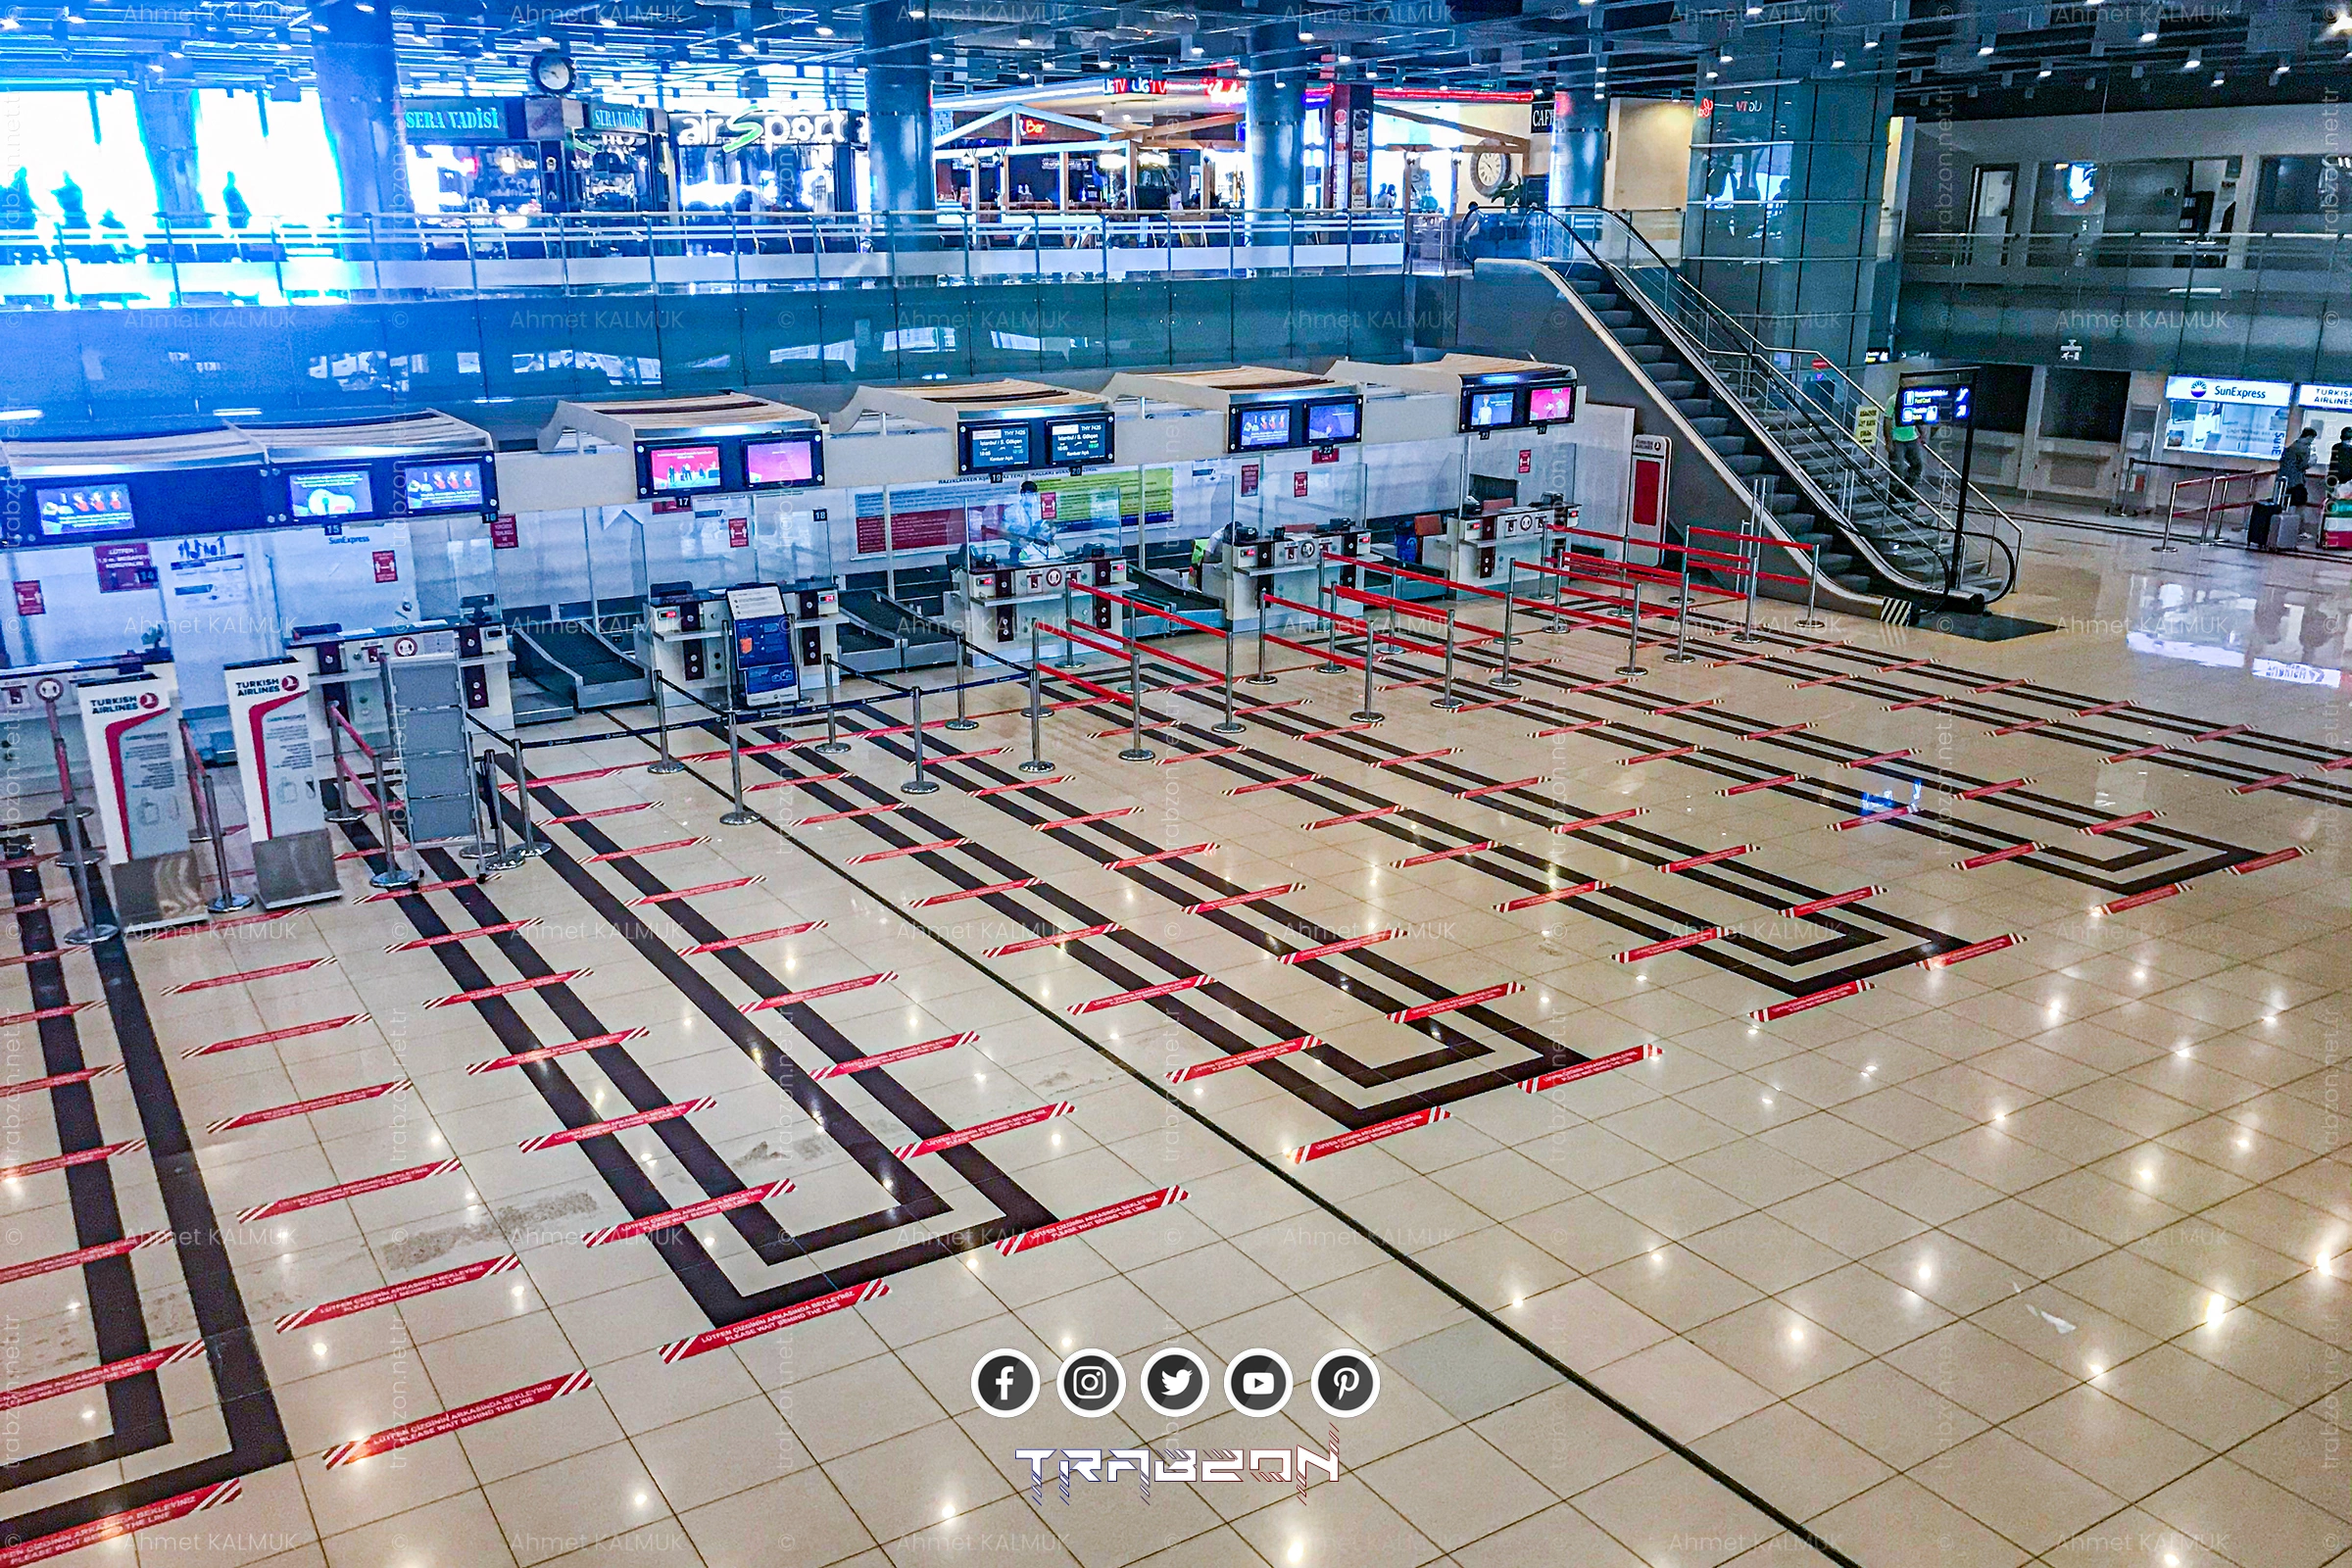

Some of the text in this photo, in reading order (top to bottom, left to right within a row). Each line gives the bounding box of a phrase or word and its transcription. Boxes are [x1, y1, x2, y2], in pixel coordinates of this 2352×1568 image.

[406, 111, 444, 128] SERA
[1025, 120, 1046, 134] Bar
[2215, 386, 2267, 400] SunExpress
[678, 498, 689, 507] 17
[326, 524, 340, 534] 15
[328, 535, 370, 545] SunExpress
[235, 678, 279, 689] TURKISH
[237, 685, 280, 697] AIRLINES
[90, 695, 137, 707] TURKISH
[92, 703, 138, 714] AIRLINES
[701, 1328, 732, 1344] LÜTFEN
[766, 1303, 810, 1323] ARKASINDA
[811, 1291, 855, 1309] BEKLEYİNİZ
[725, 1301, 840, 1343] PLEASE WAIT BEHIND THE LINE
[373, 1427, 409, 1445] LÜTFEN
[452, 1398, 503, 1421] ARKASINDA
[504, 1383, 554, 1405] BEKLEYİNİZ
[400, 1396, 534, 1443] PLEASE WAIT BEHIND THE LINE
[10, 1546, 50, 1566] PLEASE
[55, 1538, 80, 1553] WAIT
[125, 1519, 145, 1533] THE
[148, 1511, 172, 1527] LINE
